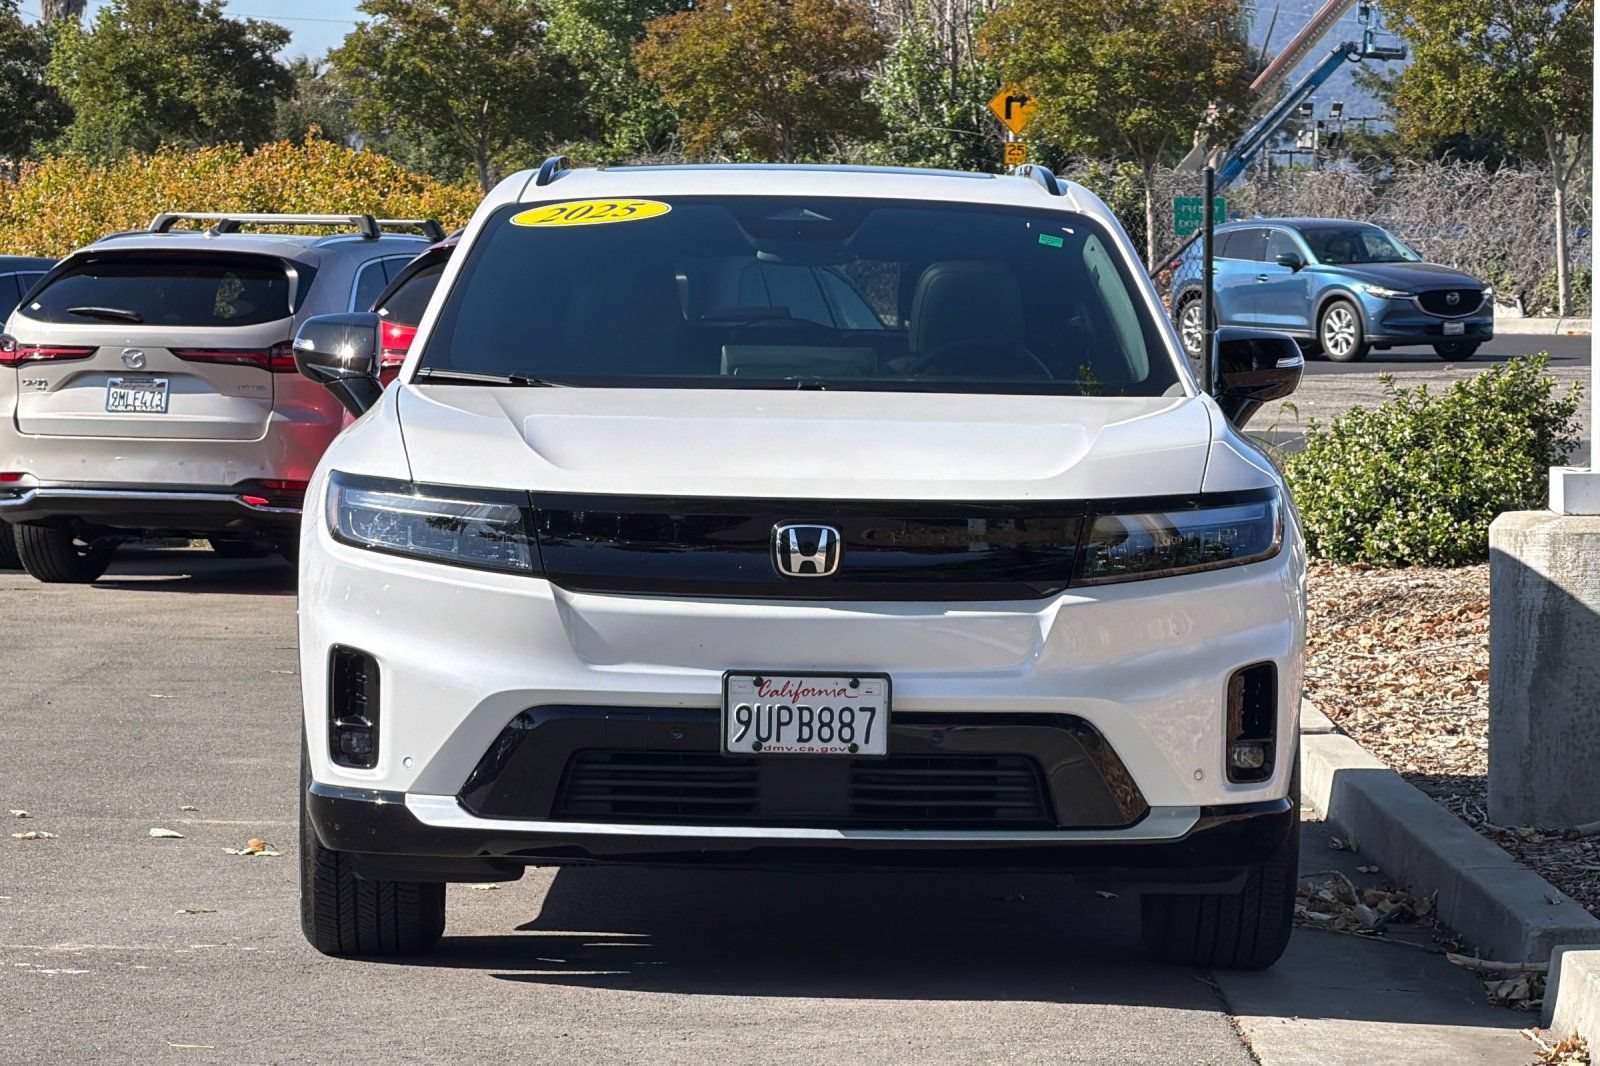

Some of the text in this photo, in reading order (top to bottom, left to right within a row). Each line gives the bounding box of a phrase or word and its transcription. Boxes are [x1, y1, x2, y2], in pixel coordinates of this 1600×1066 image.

[1008, 144, 1025, 155] 25
[535, 203, 646, 223] 2025
[111, 390, 163, 408] 9MLF473
[758, 679, 858, 704] California
[732, 703, 877, 745] 9UPB887
[763, 745, 847, 754] dmv.ca.gov
